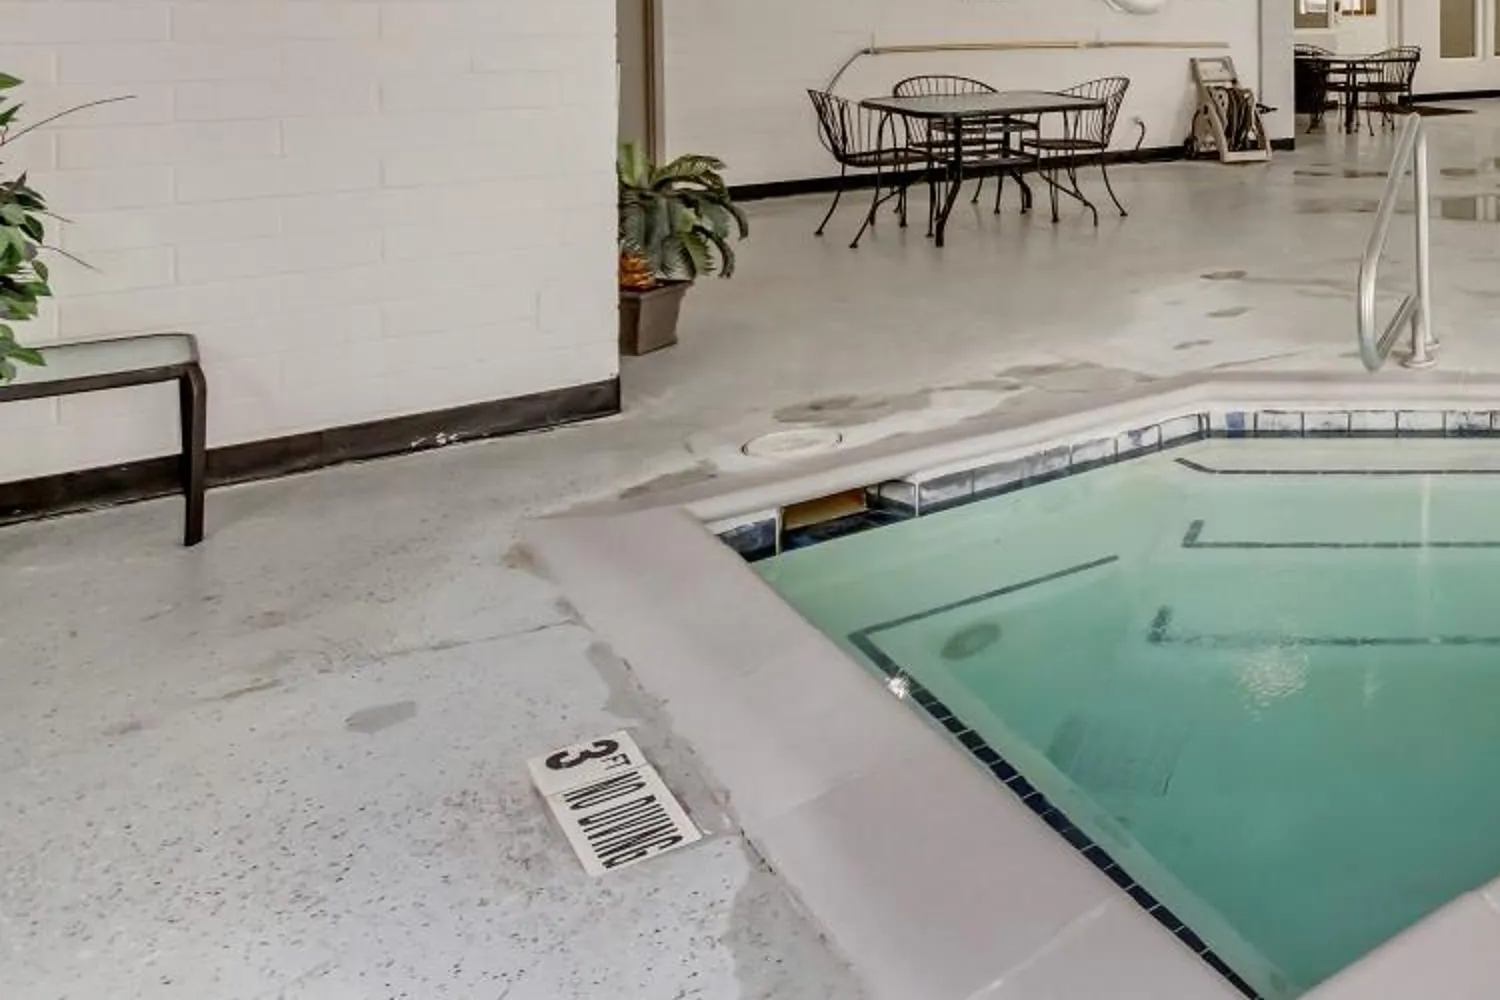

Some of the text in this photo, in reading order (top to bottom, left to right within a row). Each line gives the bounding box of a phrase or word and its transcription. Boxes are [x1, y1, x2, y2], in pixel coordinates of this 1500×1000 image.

[545, 739, 632, 771] 3 FT
[563, 771, 684, 869] NO DIVING
